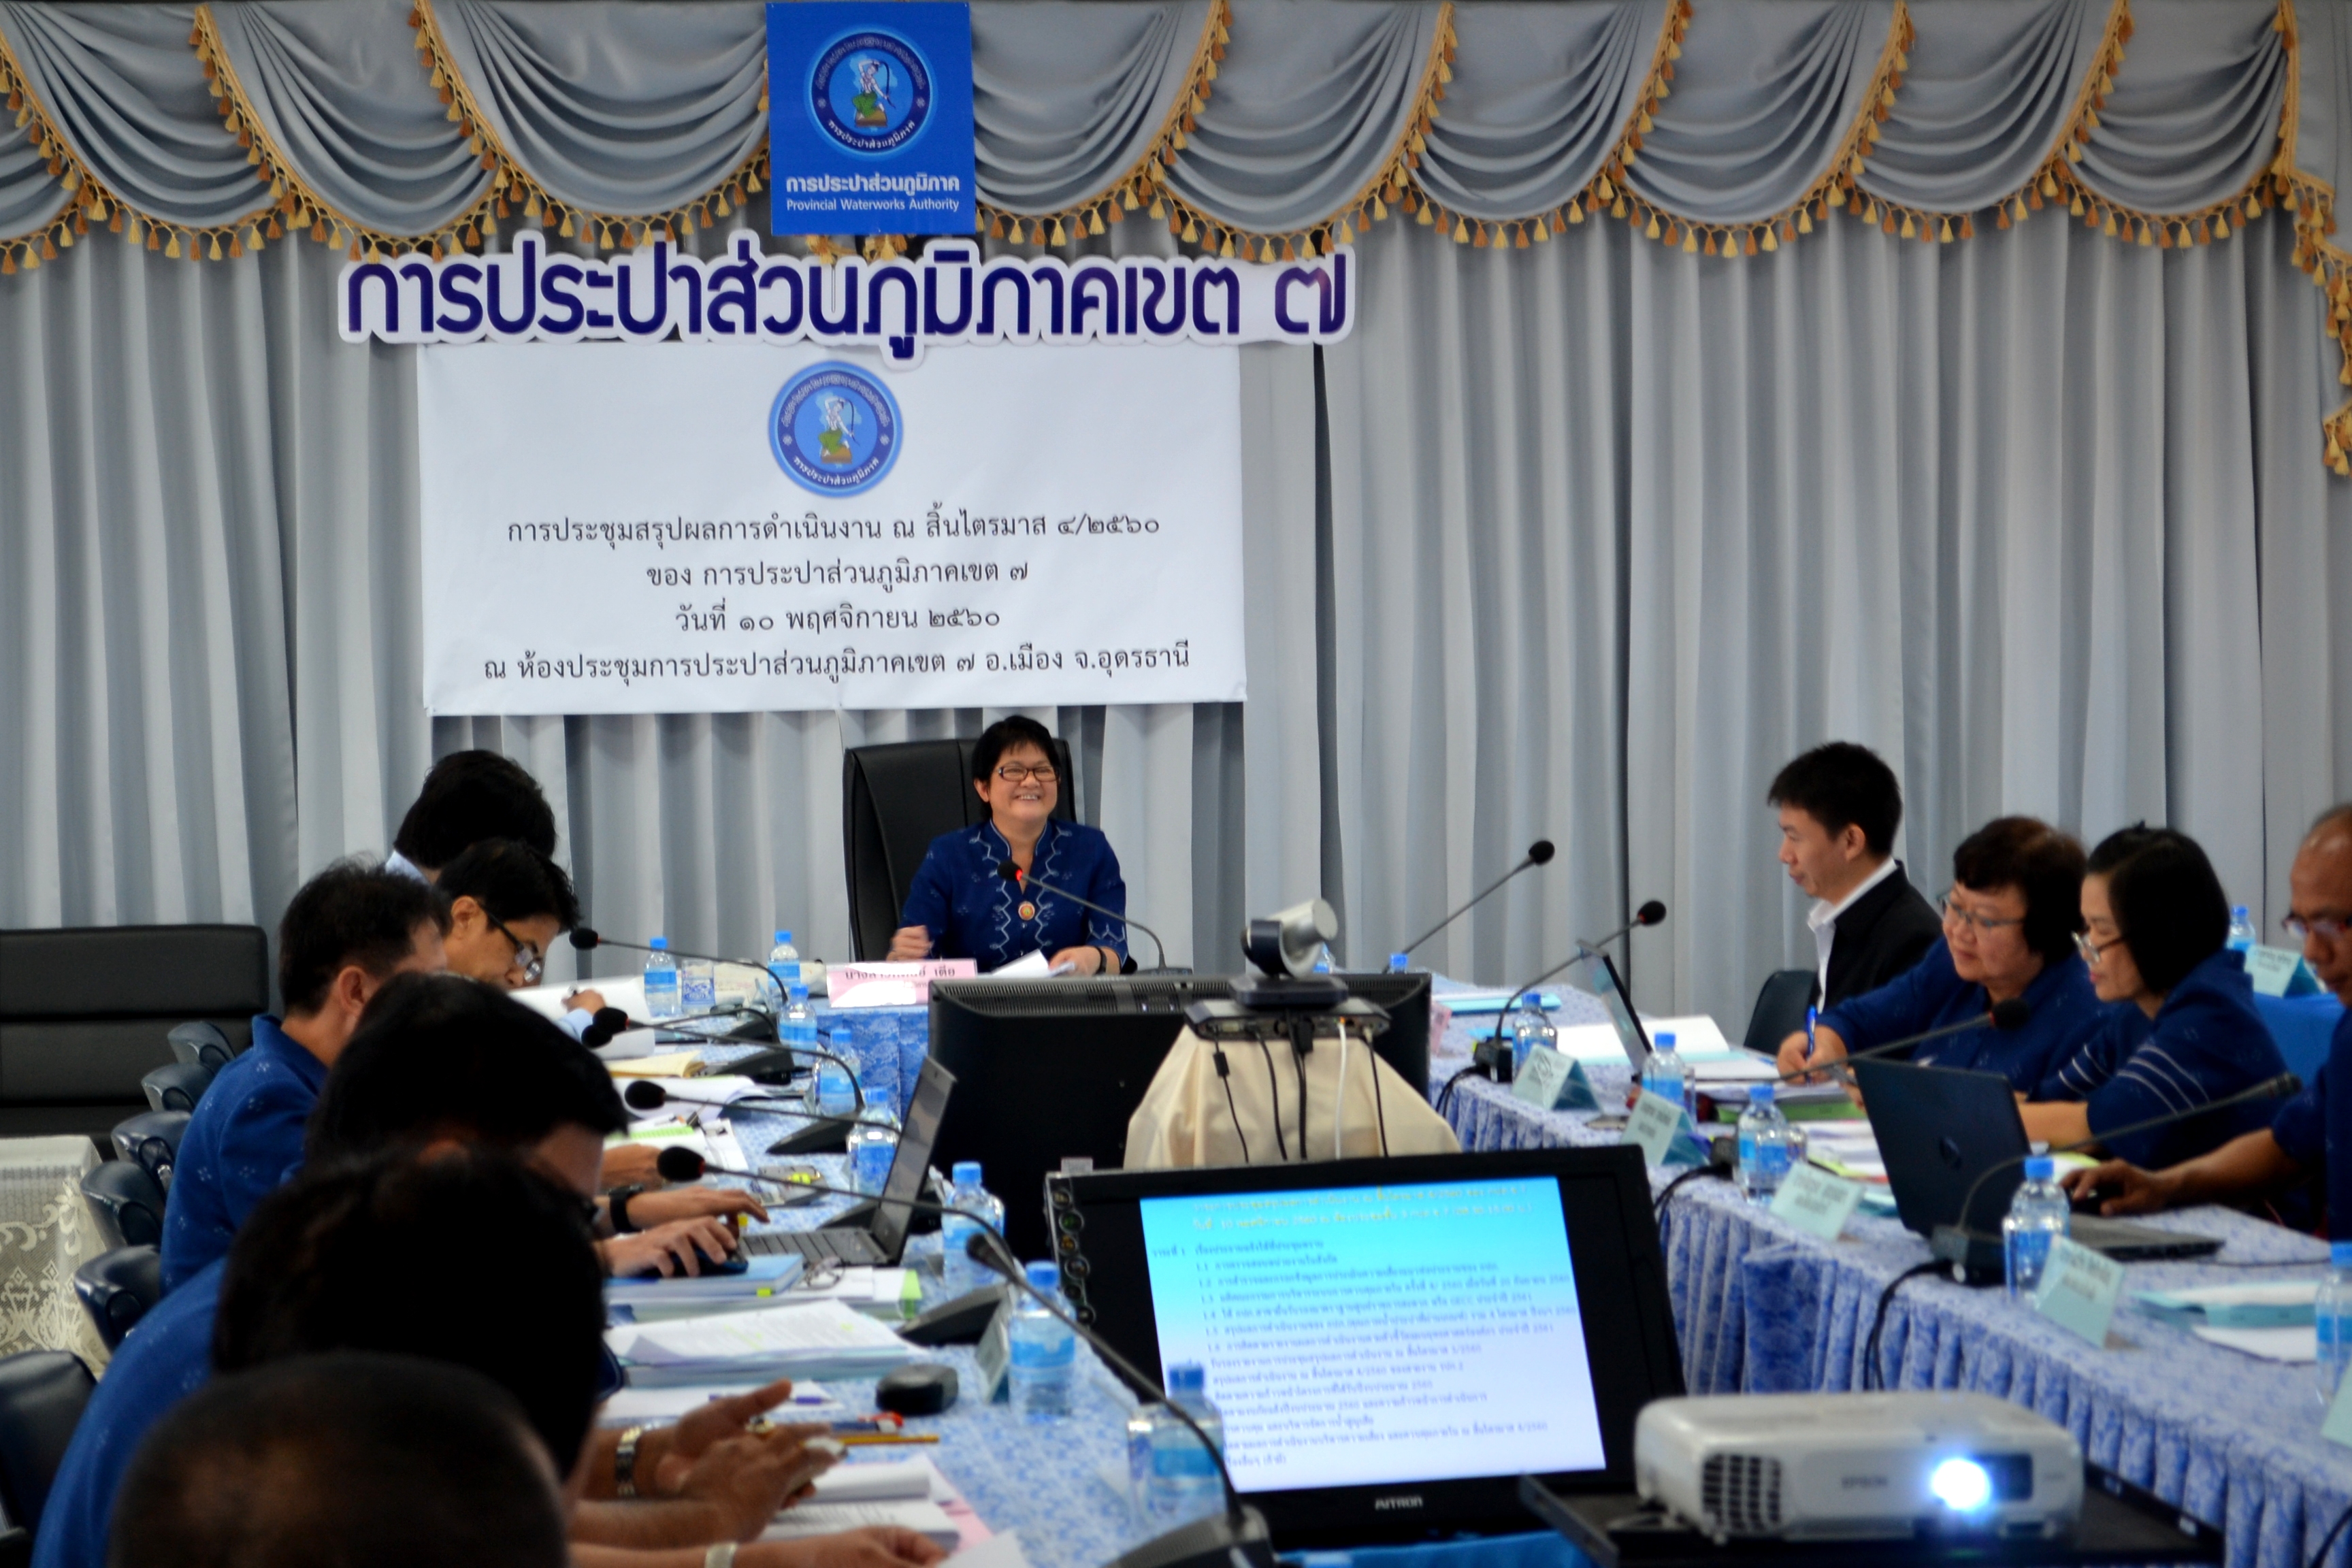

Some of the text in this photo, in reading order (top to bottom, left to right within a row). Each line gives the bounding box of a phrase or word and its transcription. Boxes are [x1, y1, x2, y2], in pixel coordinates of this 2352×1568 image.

[786, 172, 960, 196] การประปาส่วนภูมิภาค
[787, 198, 959, 212] Provincial Waterworks Authority
[348, 239, 1347, 359] การประปาส่วนภูมิภาคเขต ๗
[508, 502, 1160, 550] การประชุมสรุปผลการดำเนินงาน ณ สิ้นไตรมาส ๔/๒๕๖๐
[646, 557, 1028, 593] ของ การประปาส่วนภูมิภาคเขต ๗
[675, 597, 1000, 635] วันที่ ๑๐ พฤศจิกายน ๒๕๖๐
[485, 639, 1190, 687] ณ ห้องประชุมการประปาส่วนภูมิภาคเขต ๗ อ.เมือง จ.อุดรธานี
